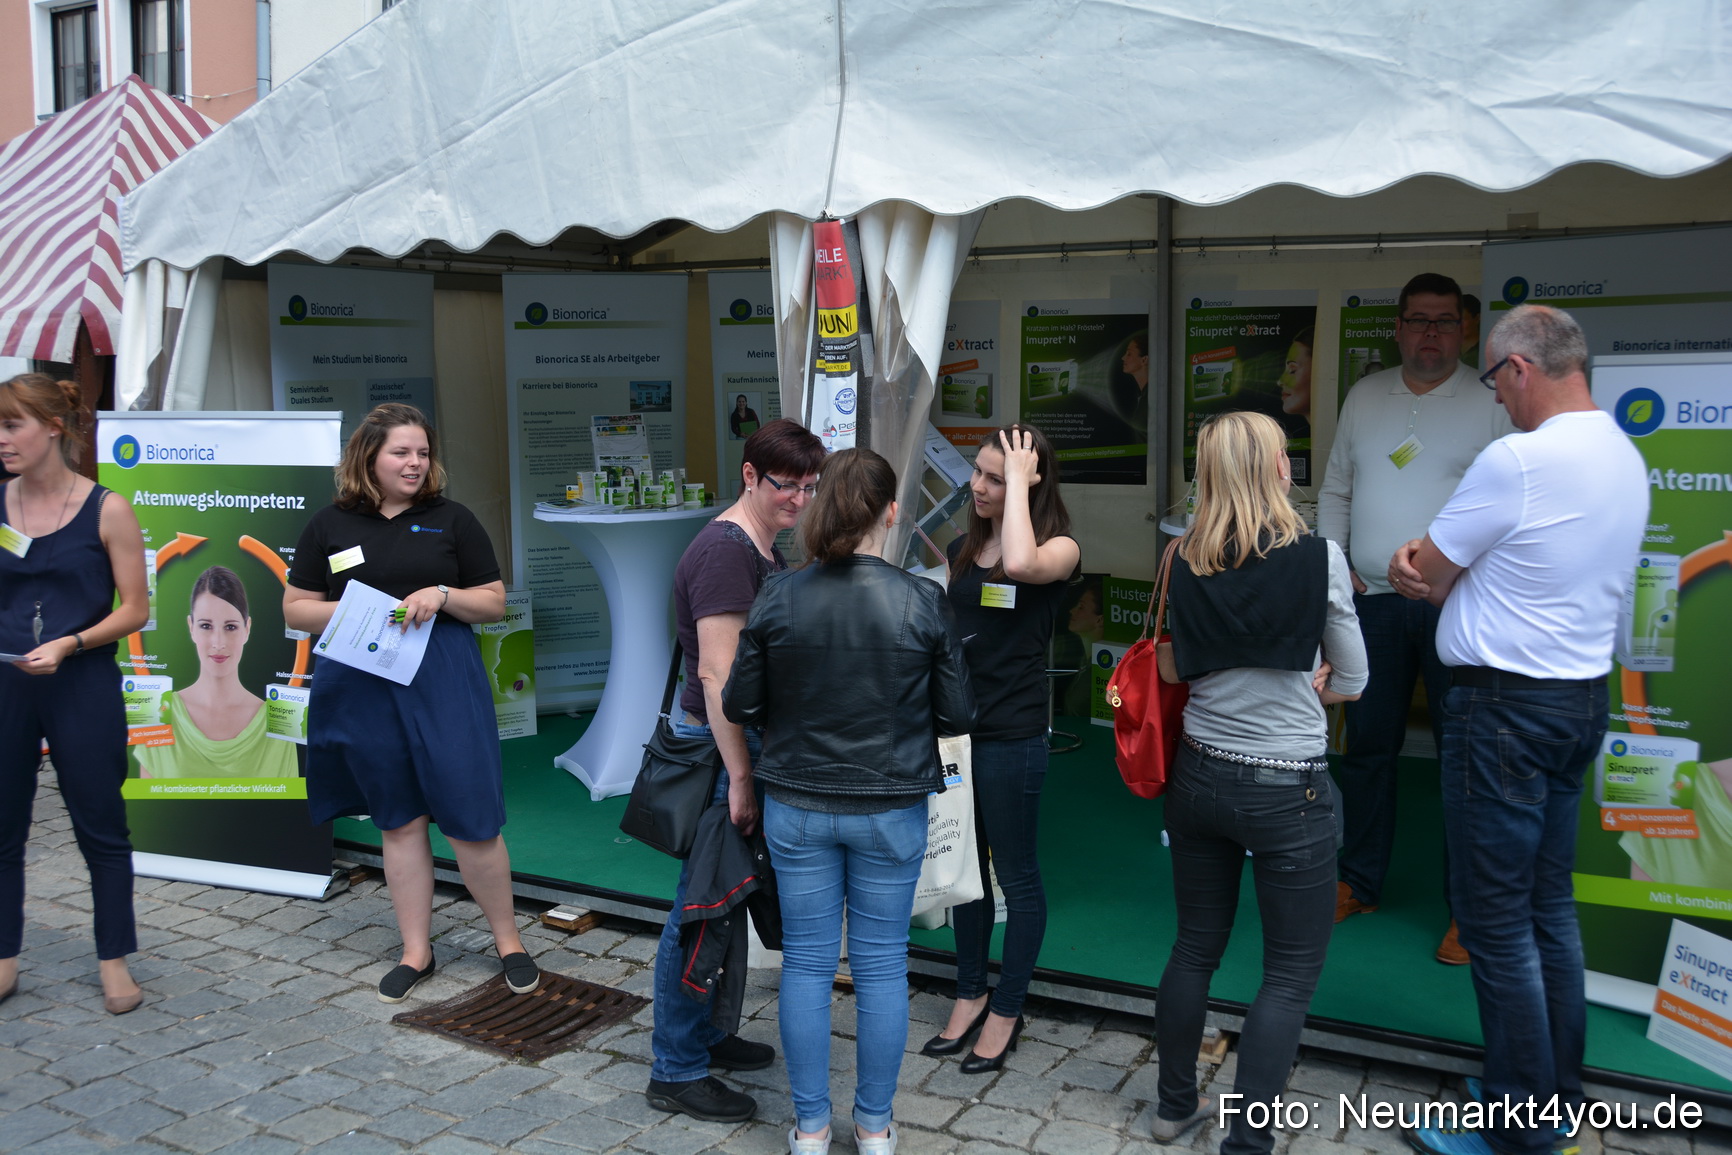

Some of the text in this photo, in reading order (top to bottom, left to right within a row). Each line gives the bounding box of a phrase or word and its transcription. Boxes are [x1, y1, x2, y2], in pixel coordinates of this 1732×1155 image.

[1535, 281, 1603, 297] Bionorica
[311, 303, 354, 316] Bionorica
[552, 308, 607, 320] Bionorica
[756, 304, 775, 316] Bio
[1222, 313, 1281, 321] Druckkopfschmerz?
[1346, 317, 1374, 325] Husten?
[1240, 325, 1281, 337] eXtract
[1345, 328, 1397, 340] Bronchipr
[948, 339, 994, 351] eXtract
[1069, 335, 1076, 344] N
[1613, 340, 1670, 351] Bionorica
[313, 354, 408, 365] Mein Studium bei Bionorica
[535, 354, 661, 365] Bionorica SE als Arbeitgeber
[747, 350, 776, 359] Meine
[290, 385, 329, 394] Semivirtuelles
[522, 381, 598, 391] Karriere bei Bionorica
[291, 396, 334, 405] Duales Studium
[390, 393, 412, 401] Studium
[952, 432, 966, 440] aller
[147, 444, 215, 461] Bionorica
[133, 490, 306, 513] Atemwegskompetenz
[1645, 523, 1669, 532] sten?
[505, 596, 529, 606] onorica
[485, 625, 508, 633] Tropfen
[535, 664, 557, 672] Weitere
[574, 669, 609, 677] www.bionori
[1096, 677, 1109, 686] Bro
[280, 693, 305, 703] Bionorica
[1622, 703, 1672, 716] Nase dicht?
[1609, 713, 1690, 729] ruckkopfschmerz?
[1631, 746, 1675, 758] Bionorica
[151, 784, 287, 795] Mit kombinierter pflanzlicher Wirkkraft
[940, 818, 960, 830] uality
[1604, 811, 1617, 826] 4
[940, 830, 961, 844] uality
[1649, 891, 1673, 905] Mit
[1669, 970, 1729, 1005] eXtract
